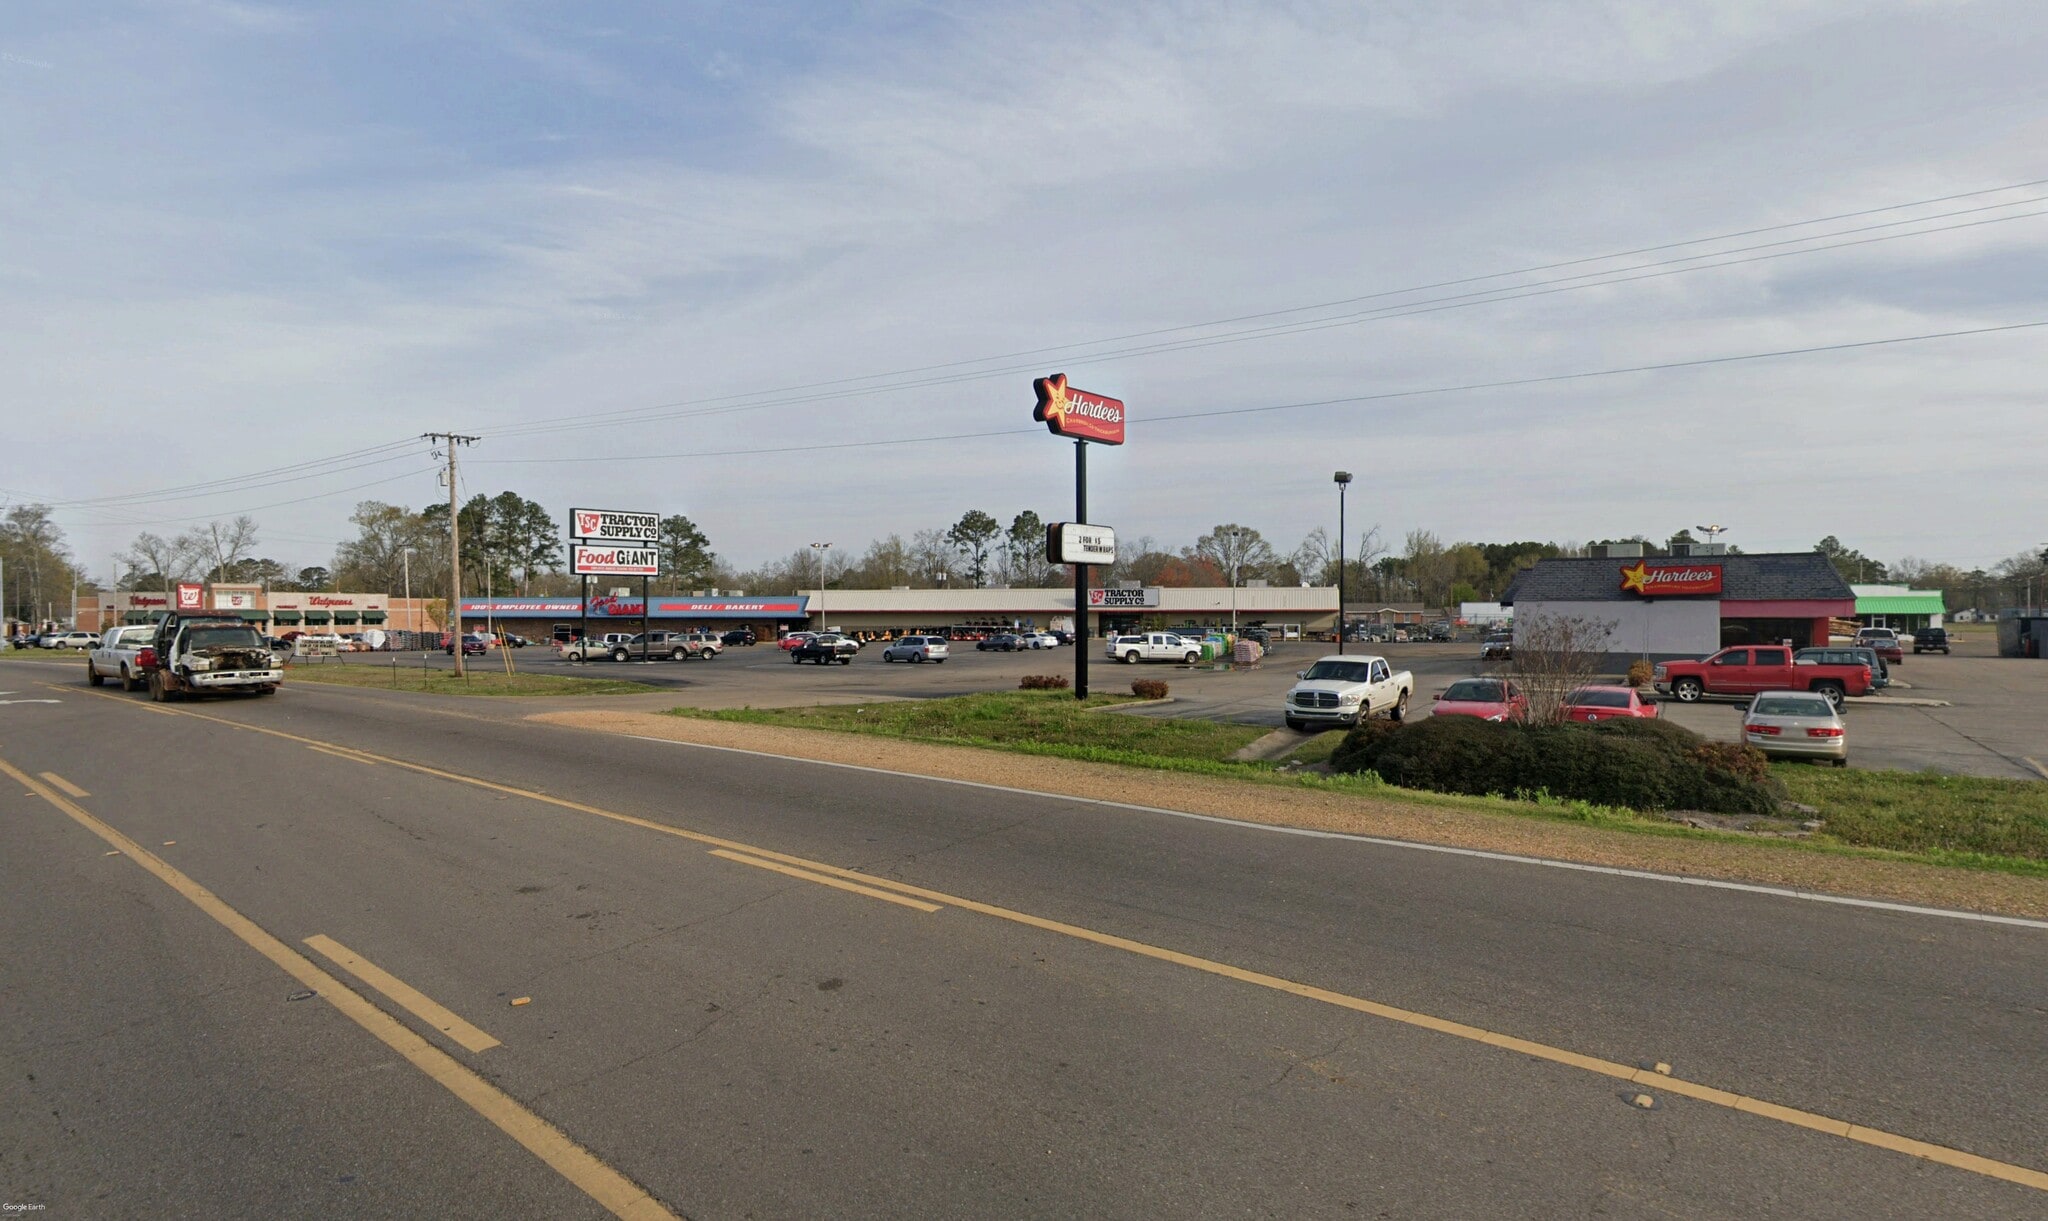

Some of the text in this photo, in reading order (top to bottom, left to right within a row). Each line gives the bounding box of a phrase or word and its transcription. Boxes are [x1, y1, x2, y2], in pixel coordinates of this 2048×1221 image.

[1064, 394, 1123, 423] Hardee's
[579, 514, 597, 531] TSC
[600, 514, 656, 527] TRACTOR
[600, 525, 644, 538] SUPPLY
[577, 549, 616, 565] Food
[1643, 569, 1717, 584] Hardee's
[1105, 589, 1144, 597] TRACTOR
[309, 596, 353, 608] Walgreens
[1105, 597, 1134, 605] SUPPLY
